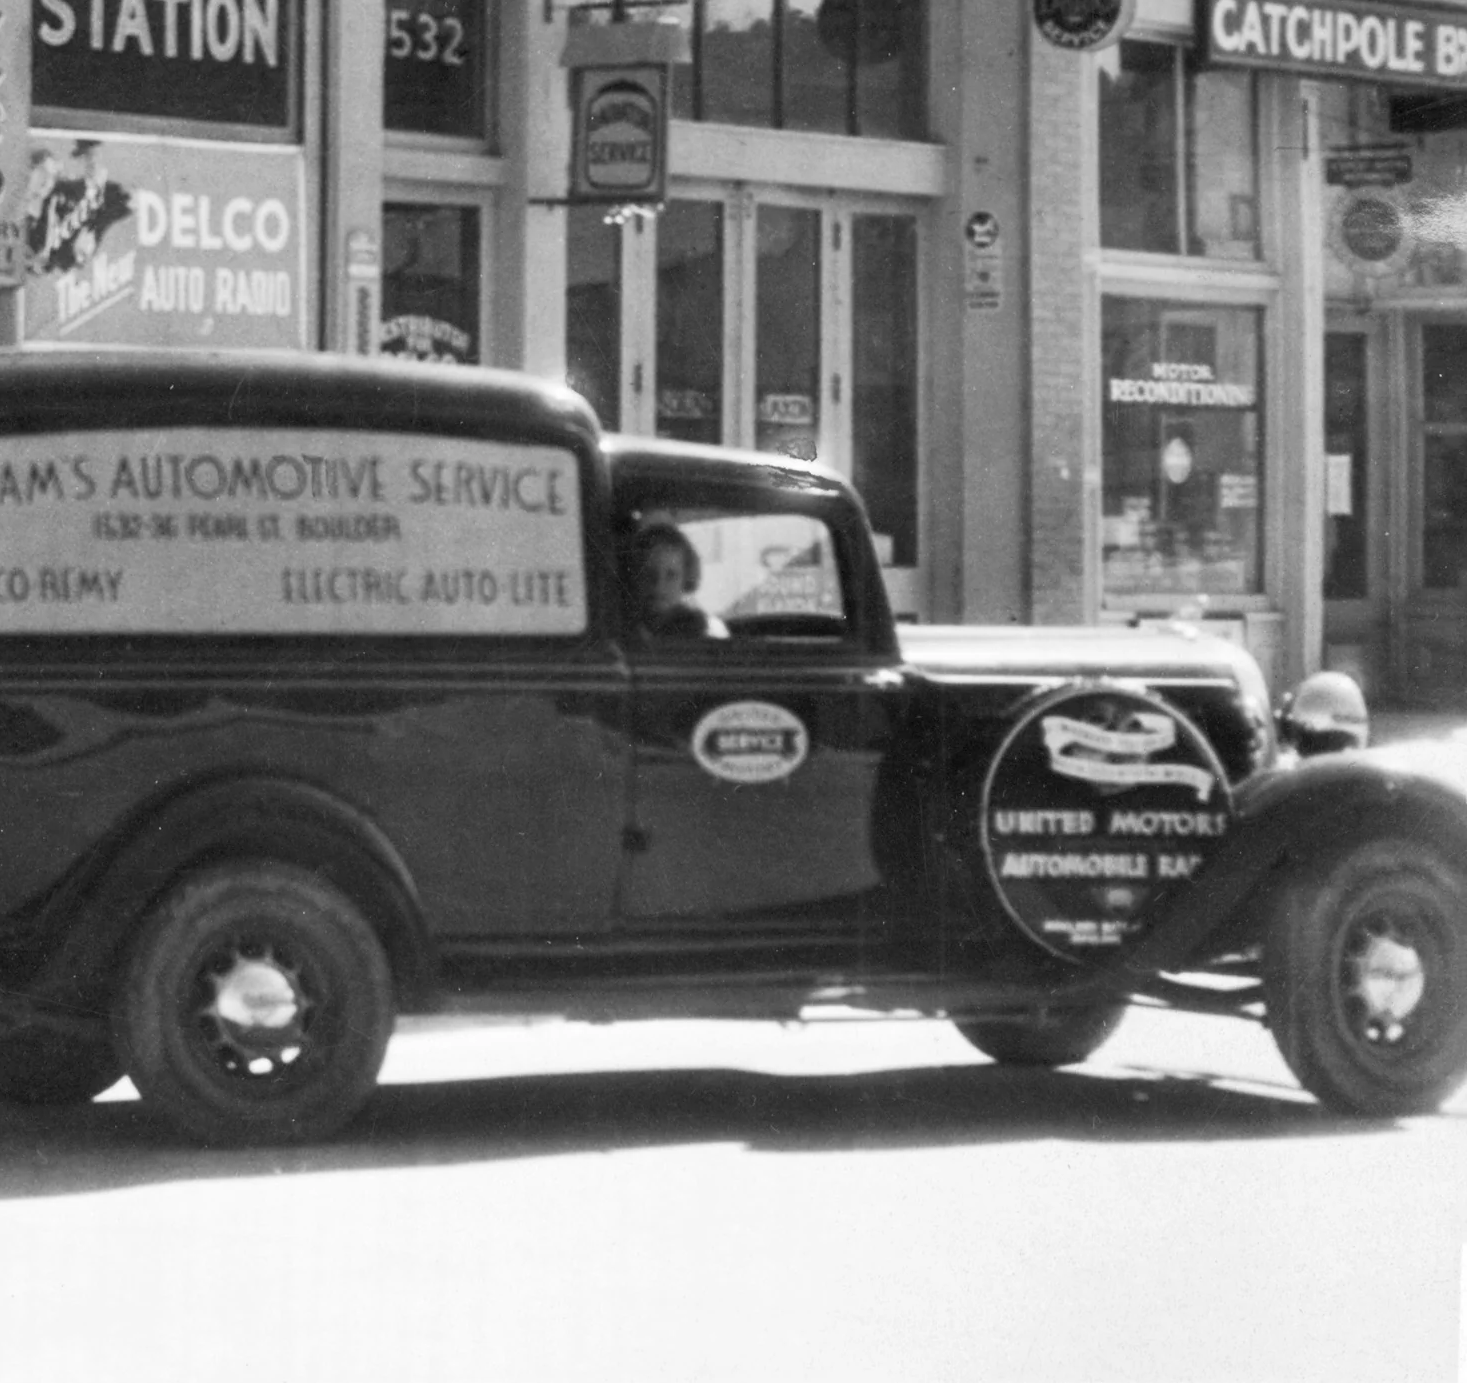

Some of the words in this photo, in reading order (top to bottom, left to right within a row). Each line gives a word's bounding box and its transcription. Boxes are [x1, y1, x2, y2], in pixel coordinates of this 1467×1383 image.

[136, 190, 291, 251] DELCO
[139, 265, 209, 313] AUTO
[214, 267, 292, 317] RADIO
[1152, 361, 1215, 381] MOTOR
[1110, 378, 1256, 407] RECONDITIONING
[111, 454, 385, 502] AUTOMOTIVE
[409, 459, 565, 517] SERVICE
[294, 514, 402, 542] BOULDER
[281, 567, 410, 605] ELECTRIC
[994, 809, 1095, 835] UNITED
[1000, 852, 1149, 879] AUTOMOBILE
